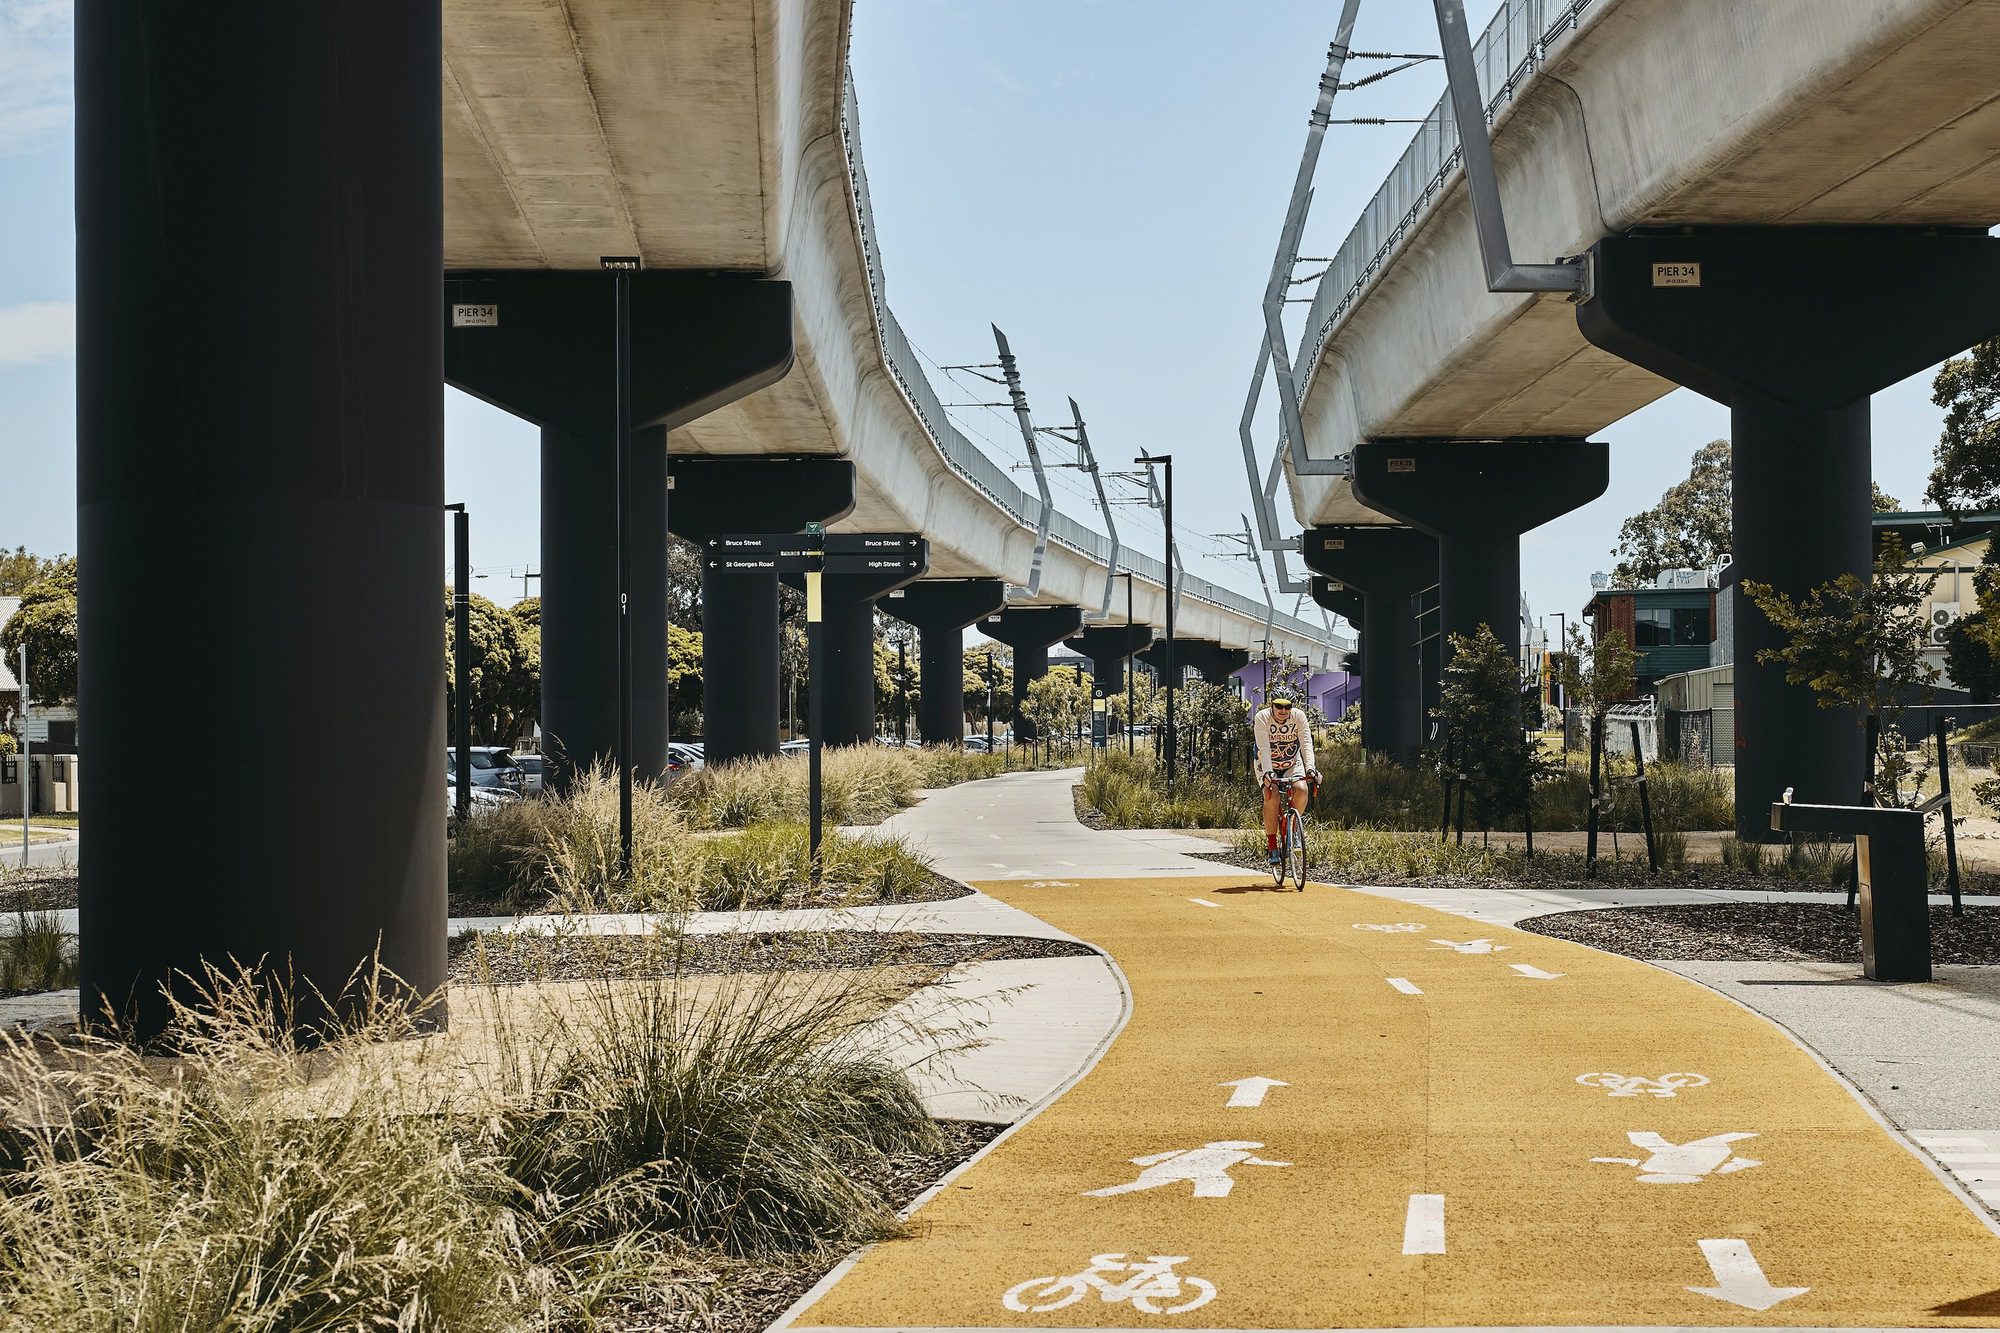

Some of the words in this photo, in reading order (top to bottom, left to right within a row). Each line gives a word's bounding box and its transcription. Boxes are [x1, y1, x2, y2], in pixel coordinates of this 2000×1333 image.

[1657, 266, 1679, 276] PIER
[1681, 266, 1695, 276] 34
[458, 308, 479, 317] PIER
[480, 308, 493, 317] 34
